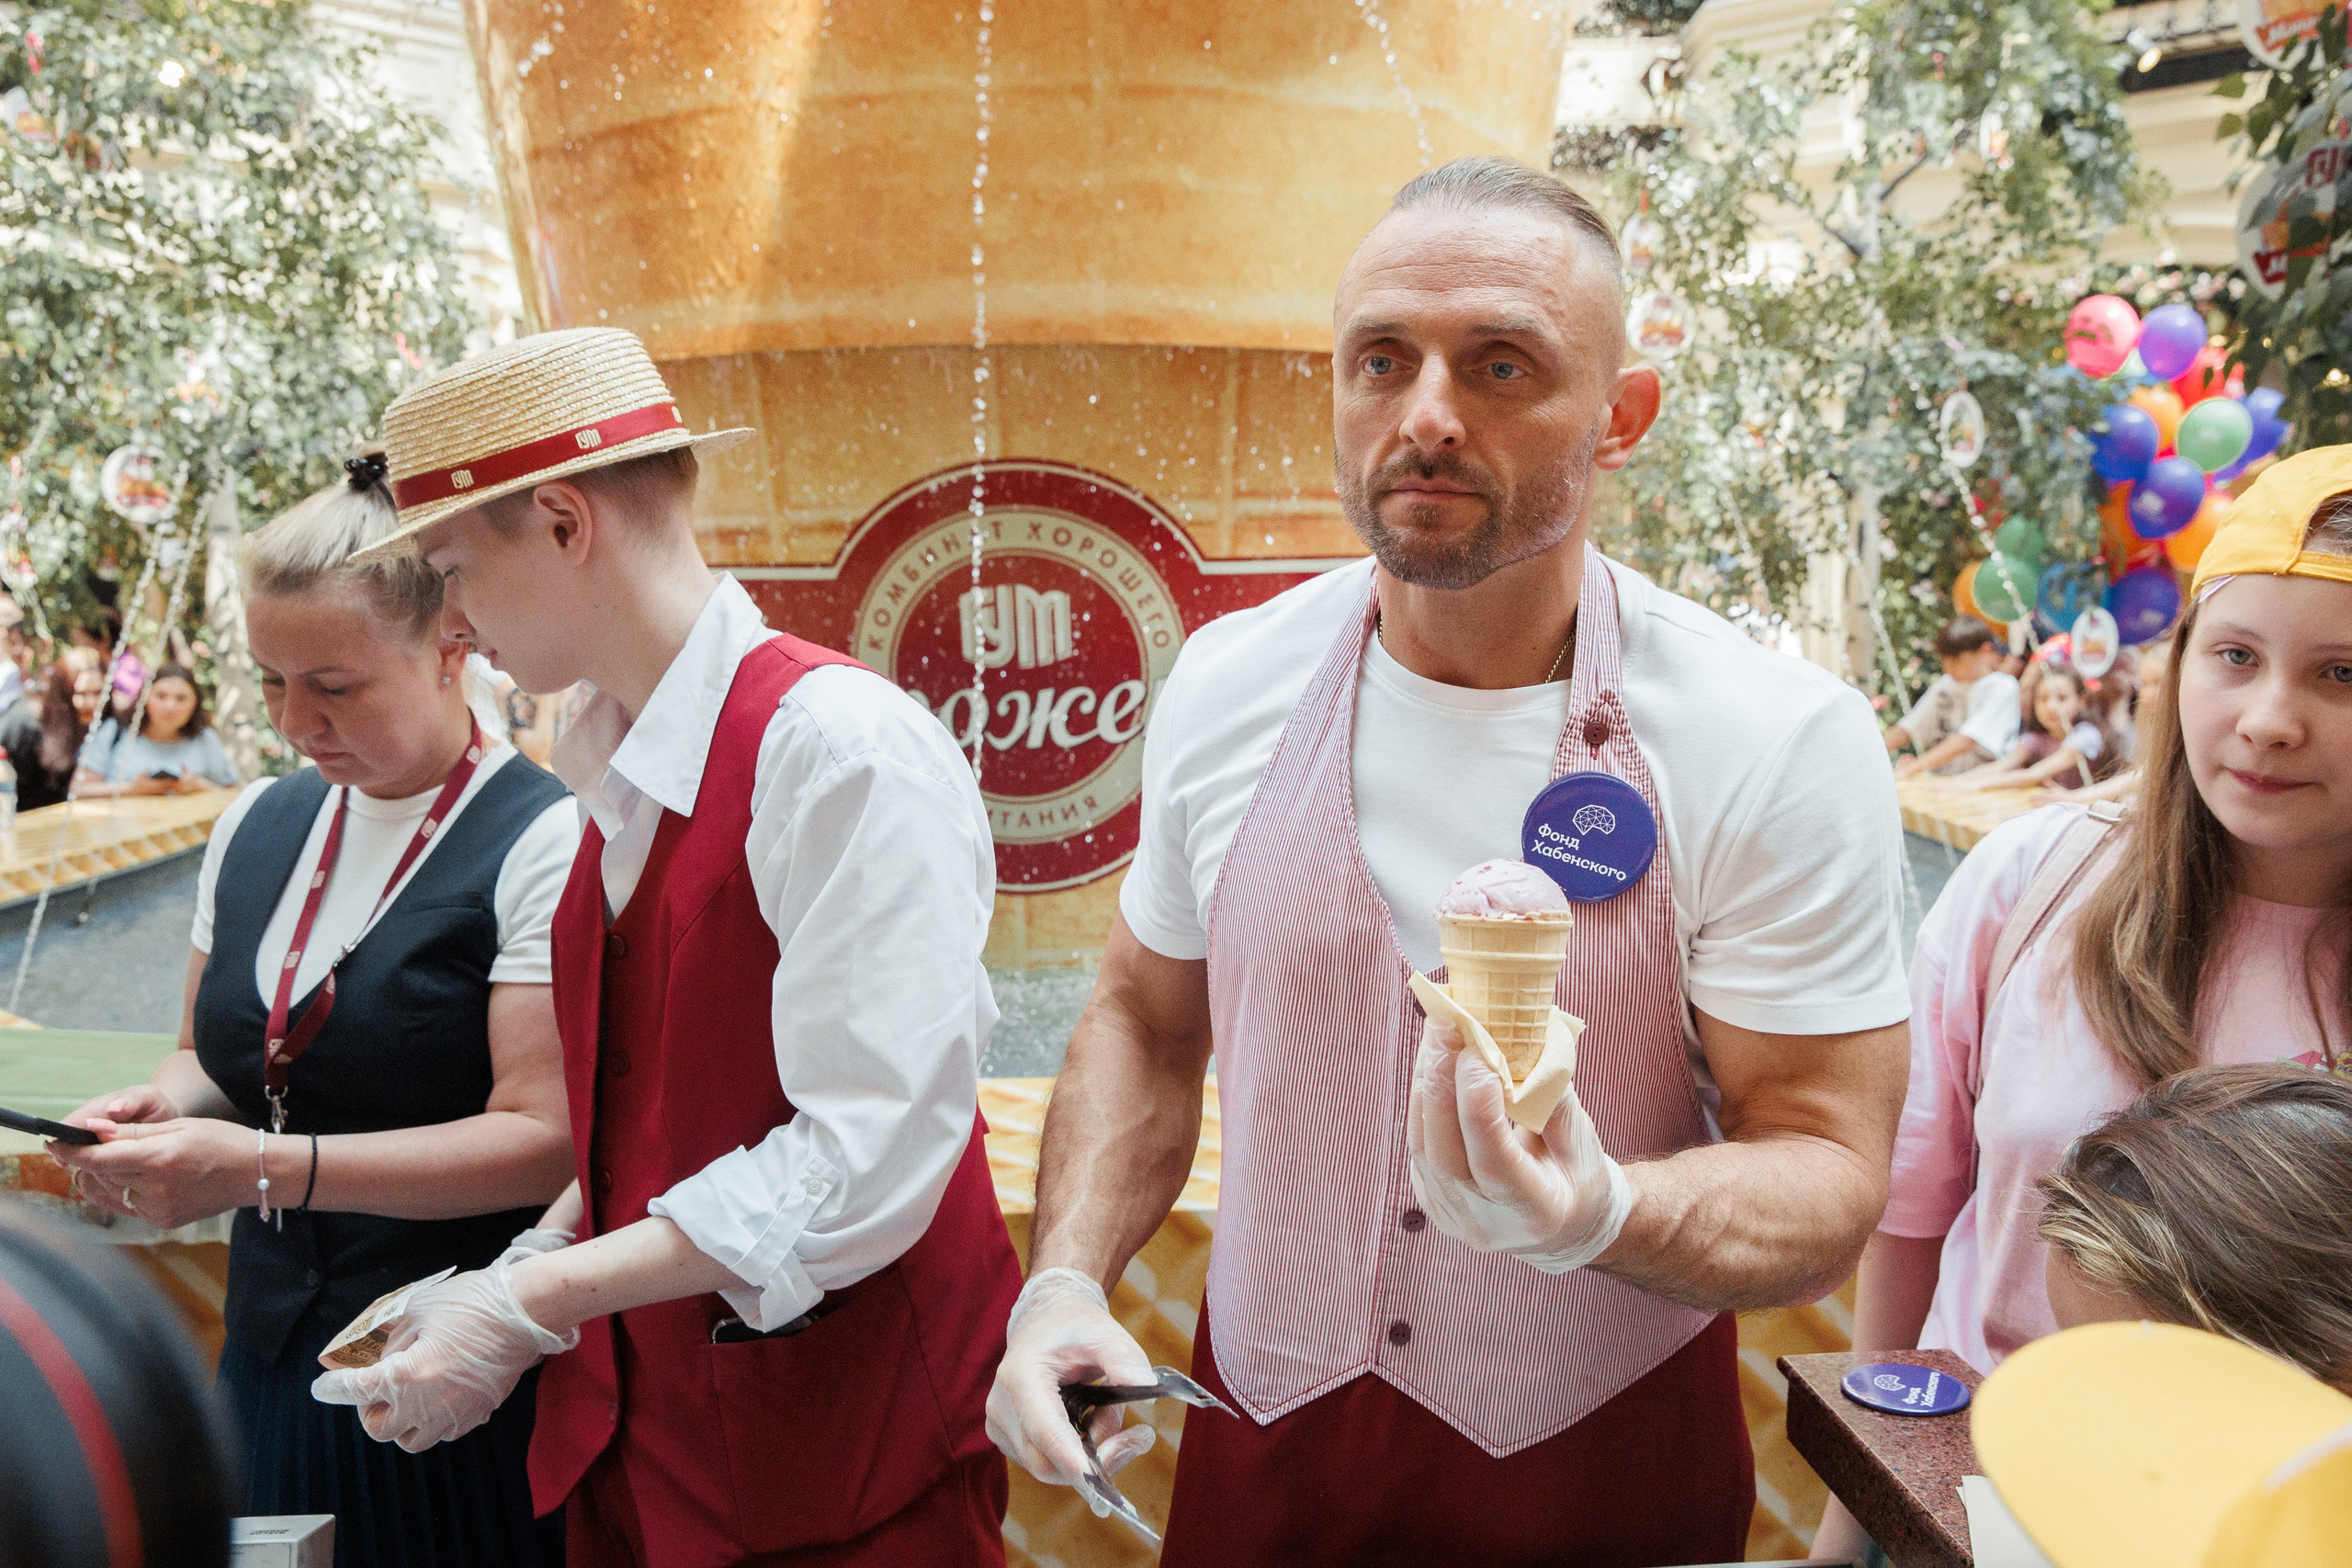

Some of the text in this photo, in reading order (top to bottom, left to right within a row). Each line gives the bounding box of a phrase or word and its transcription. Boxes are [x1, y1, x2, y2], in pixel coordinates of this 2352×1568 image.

[1027, 520, 1170, 649] ХОРОШЕГО
[959, 583, 1073, 671] ГУМ
[906, 673, 1168, 750] оже
[1532, 840, 1627, 881] Хабенского
[1538, 823, 1580, 851] Фонд
